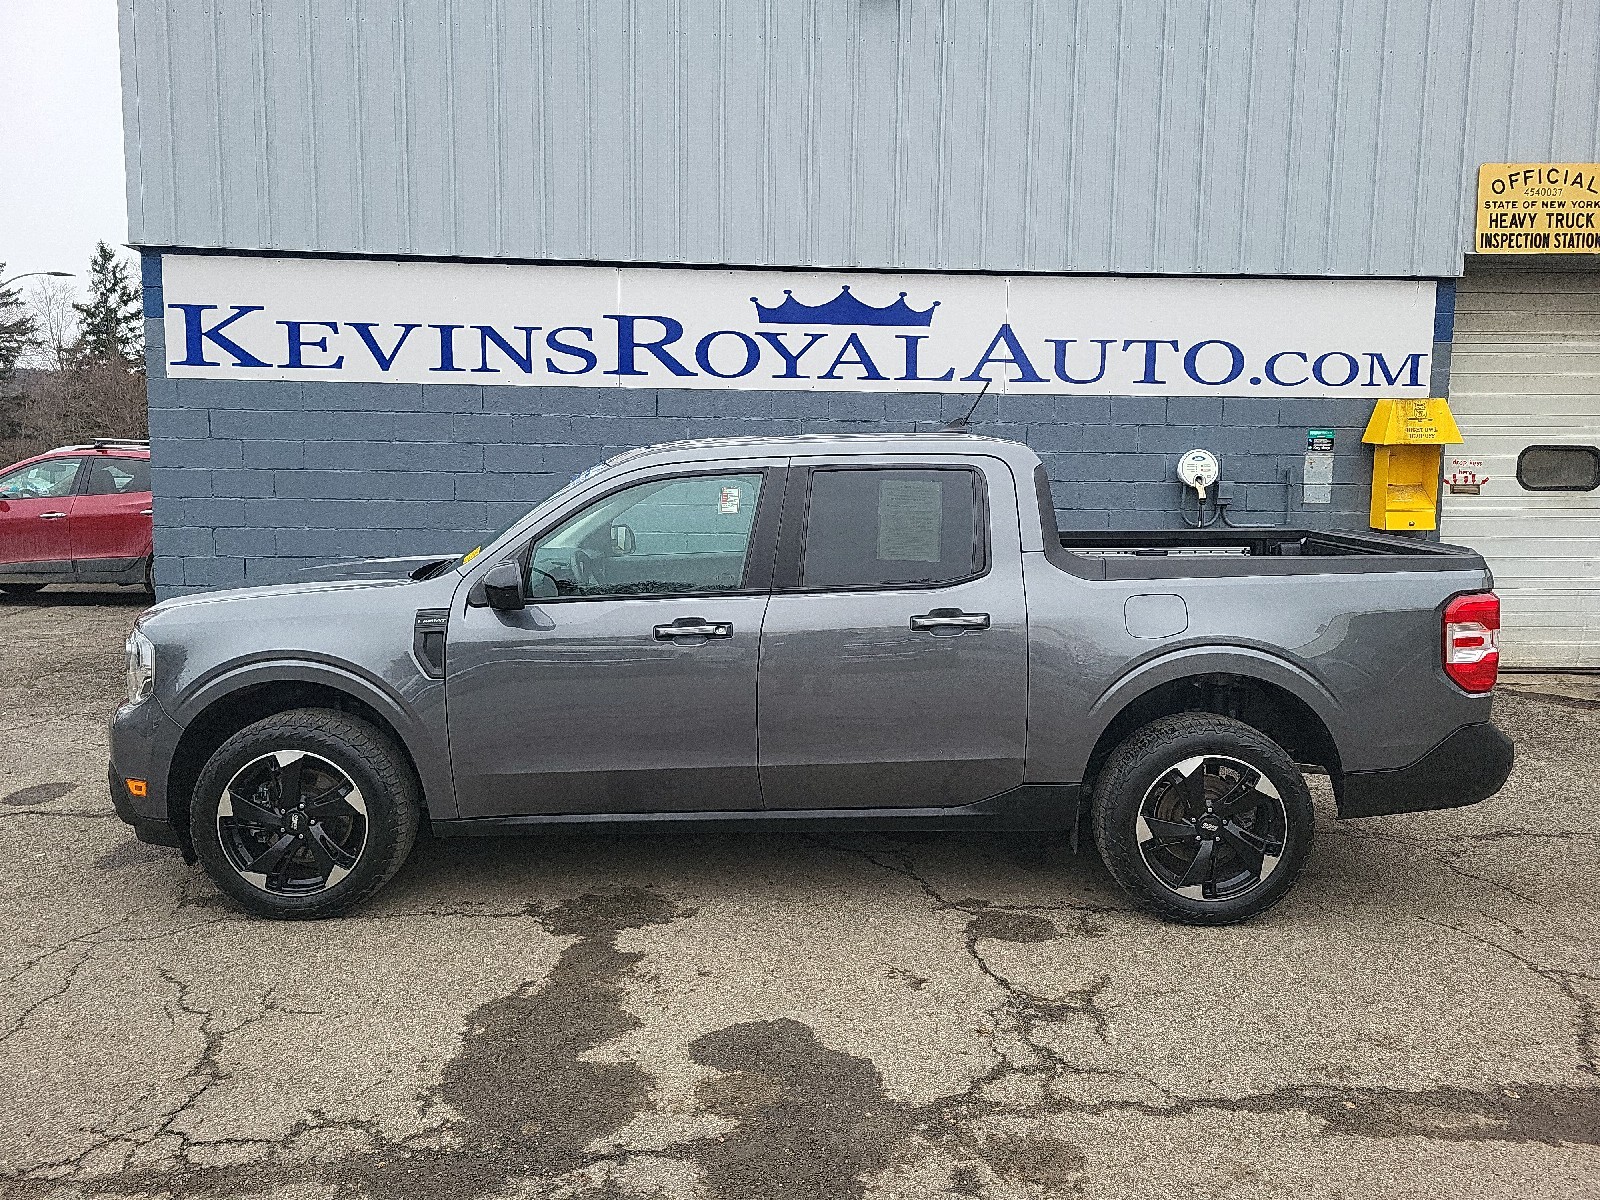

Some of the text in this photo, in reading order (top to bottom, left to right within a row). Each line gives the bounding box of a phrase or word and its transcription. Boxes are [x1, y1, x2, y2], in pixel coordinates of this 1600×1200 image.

[1491, 168, 1598, 195] OFFICIAL
[1523, 187, 1563, 197] 4540037
[1484, 200, 1600, 209] STATE OF NEW YORK
[1489, 212, 1595, 229] HEAVY TRUCK
[1480, 232, 1550, 249] INSPECTION
